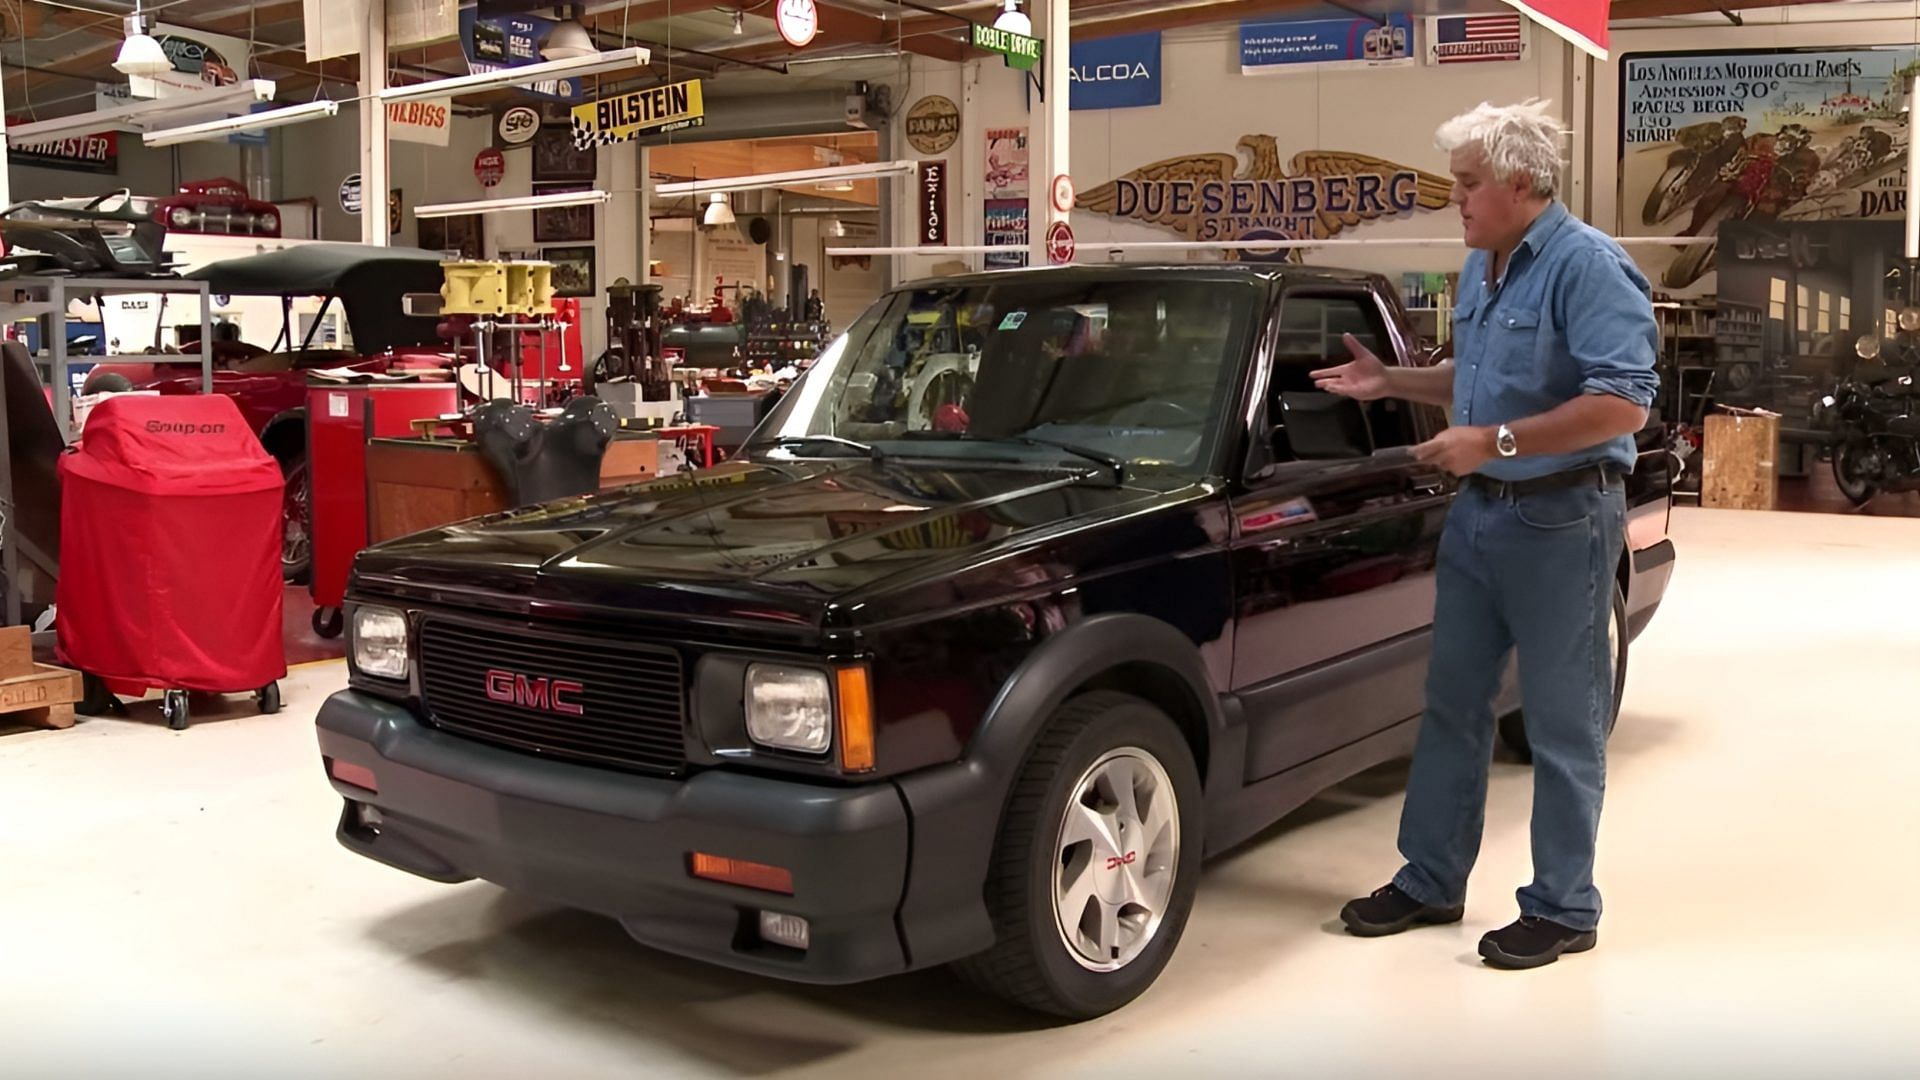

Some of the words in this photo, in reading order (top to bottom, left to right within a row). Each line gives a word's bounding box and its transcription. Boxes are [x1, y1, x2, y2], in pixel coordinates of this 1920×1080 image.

[1070, 62, 1150, 82] ALCOA
[597, 83, 688, 131] BILSTEIN
[1692, 99, 1744, 113] BEGIN
[1115, 172, 1418, 217] DUESENBERG
[1203, 215, 1316, 239] STRAIGHT
[485, 669, 584, 715] GMC
